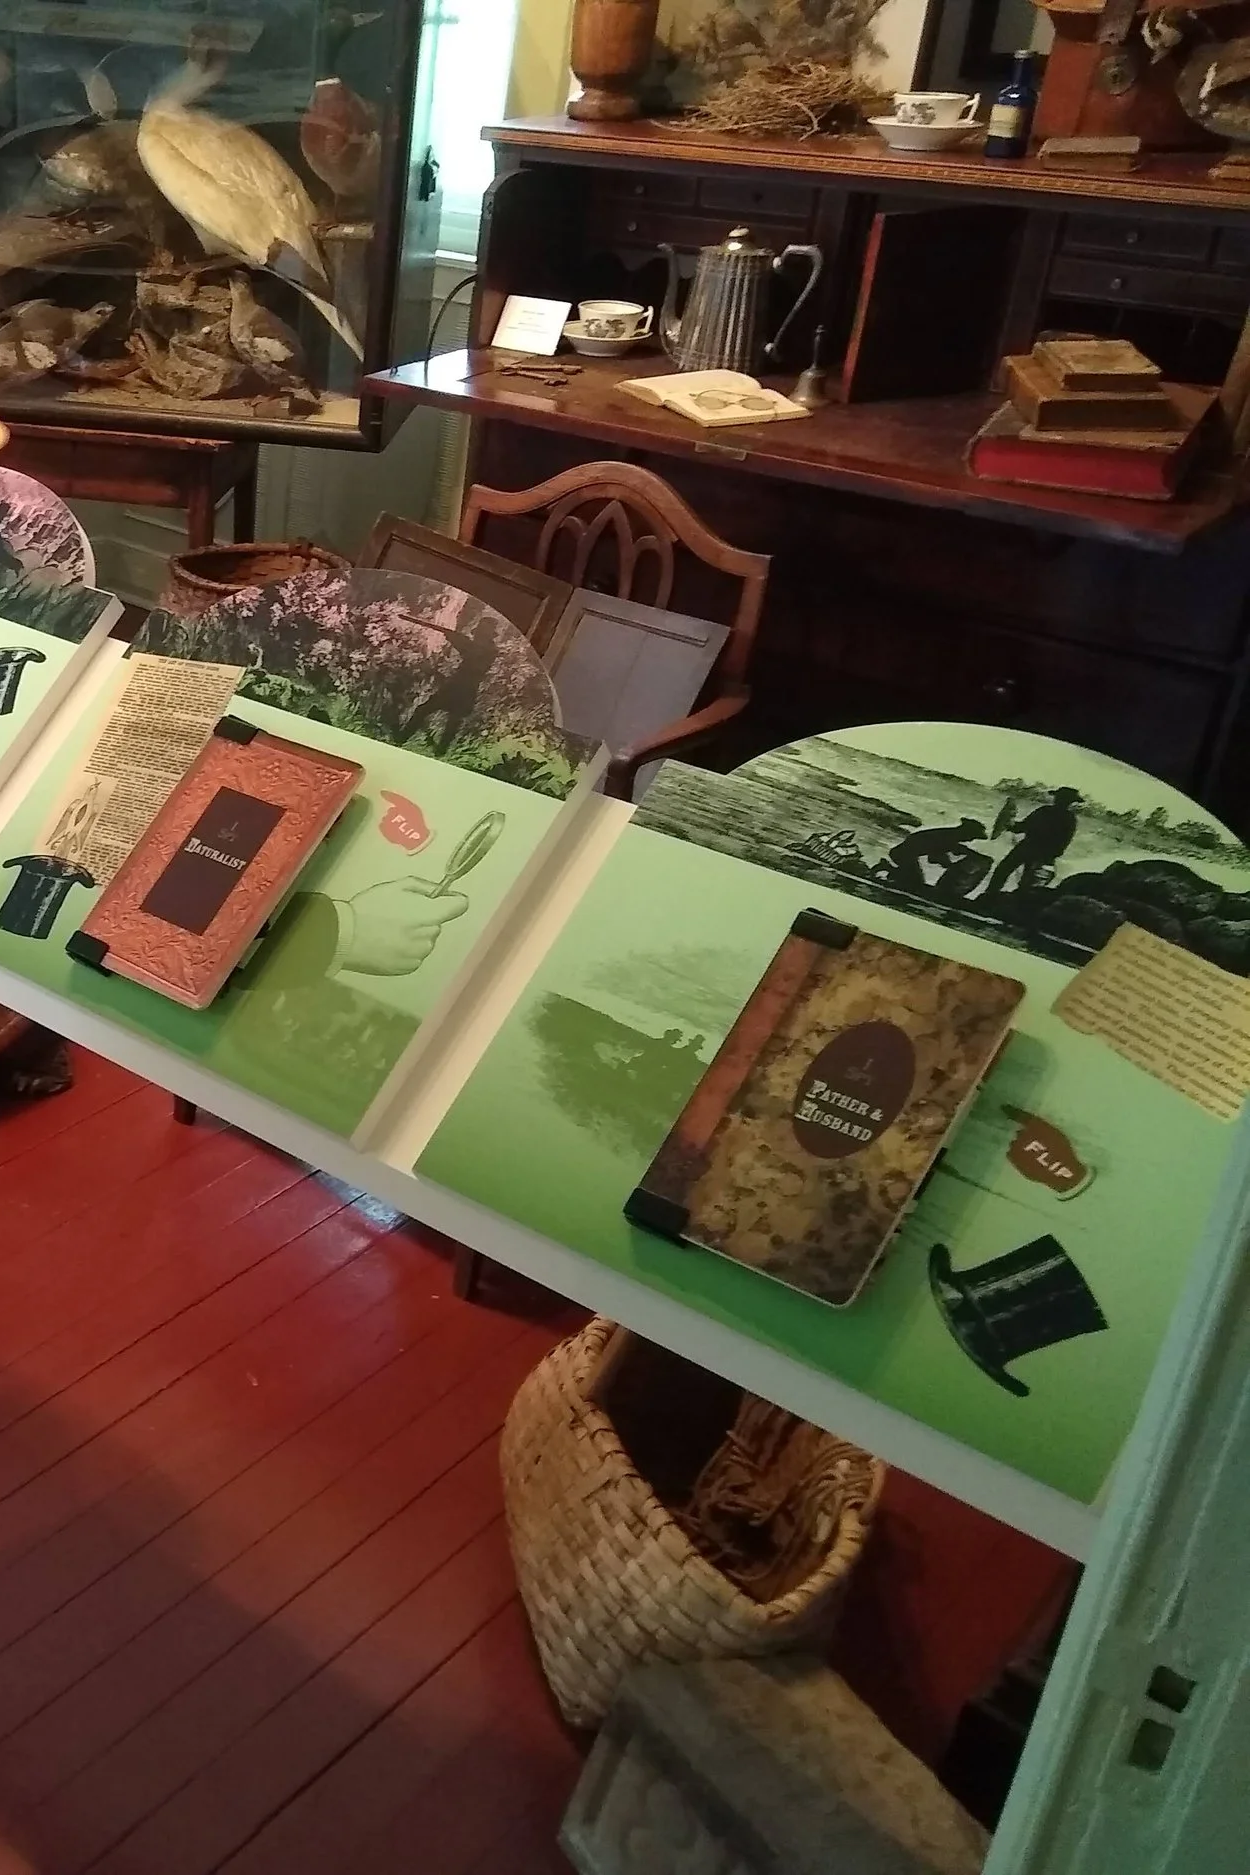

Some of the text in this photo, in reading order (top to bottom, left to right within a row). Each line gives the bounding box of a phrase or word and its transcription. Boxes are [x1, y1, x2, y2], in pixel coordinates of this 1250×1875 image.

[391, 814, 420, 840] FLIP
[184, 837, 247, 870] NATURALIST
[805, 1080, 883, 1121] FATHER &
[794, 1100, 872, 1141] HUSBAND
[1023, 1140, 1074, 1178] FLIP
